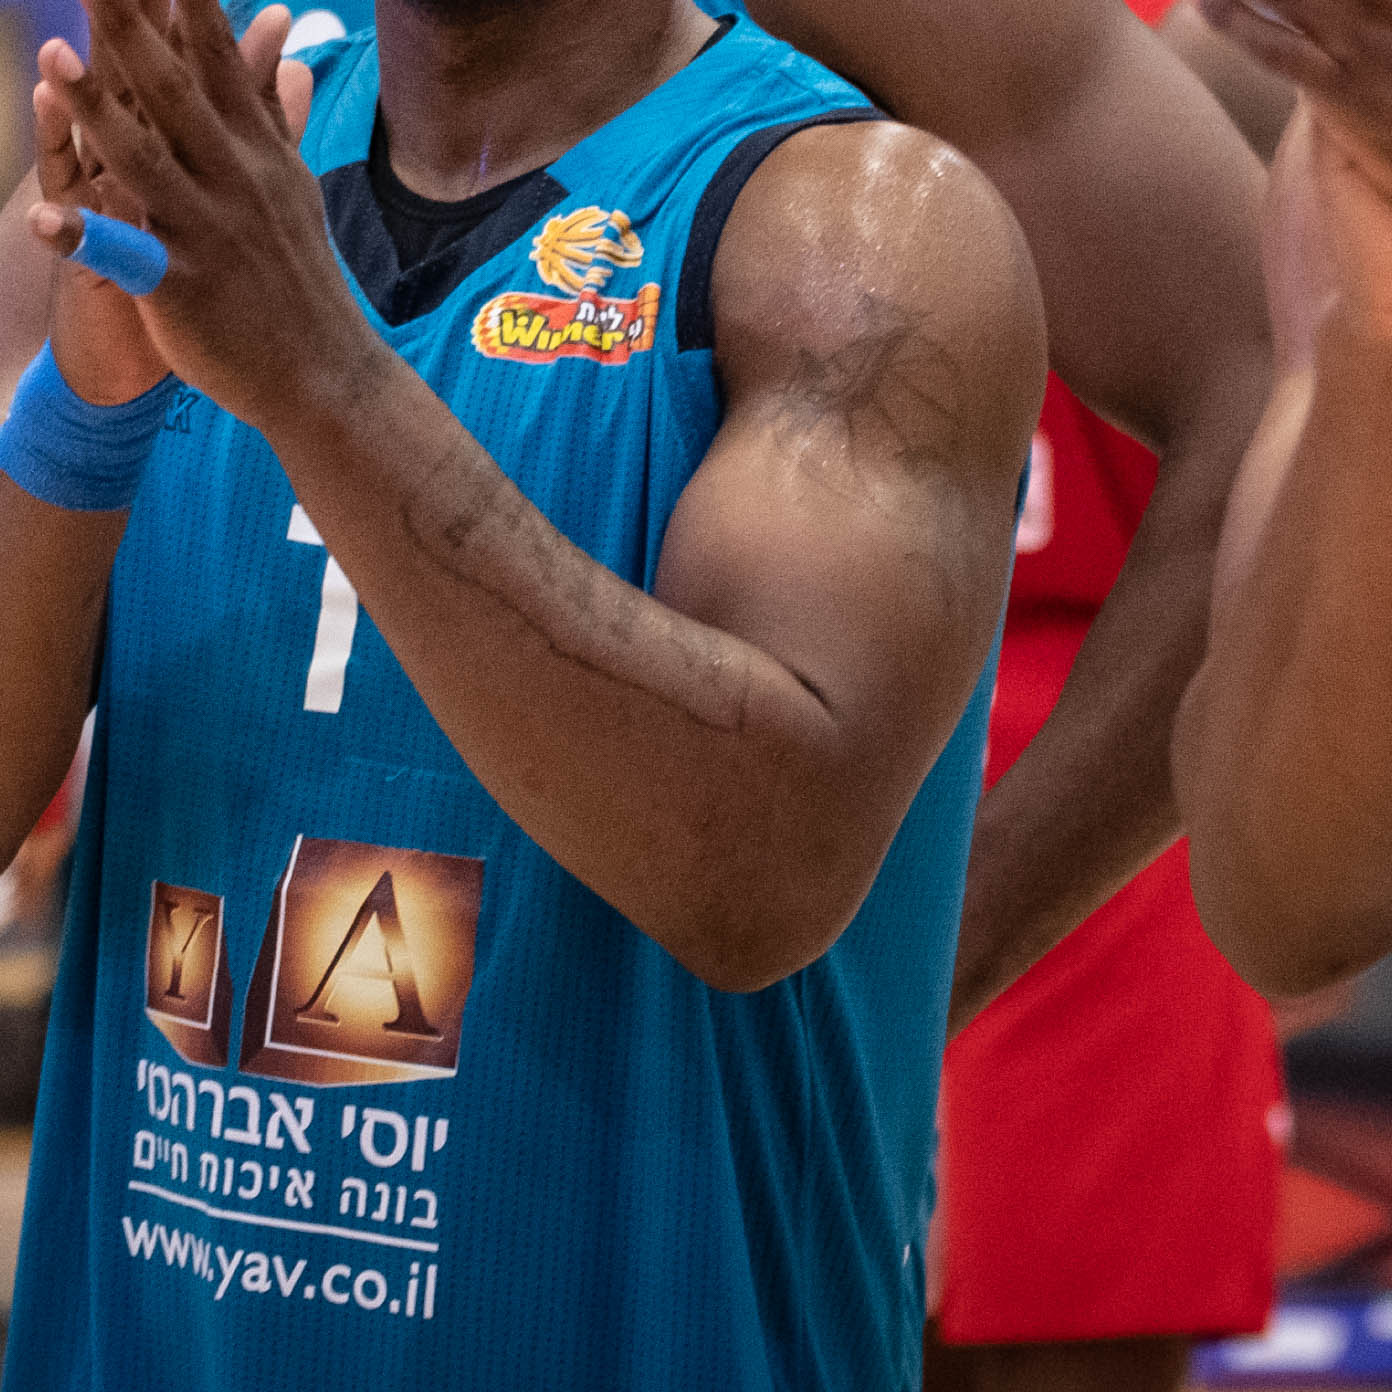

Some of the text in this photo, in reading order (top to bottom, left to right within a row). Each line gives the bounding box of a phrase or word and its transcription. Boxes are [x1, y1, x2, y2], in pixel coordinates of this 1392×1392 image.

[159, 869, 446, 1044] Y A
[136, 1059, 450, 1173] יוסי אברהמי
[133, 1129, 440, 1230] בונה איכות חיים
[121, 1215, 440, 1321] www.yav.co.il
